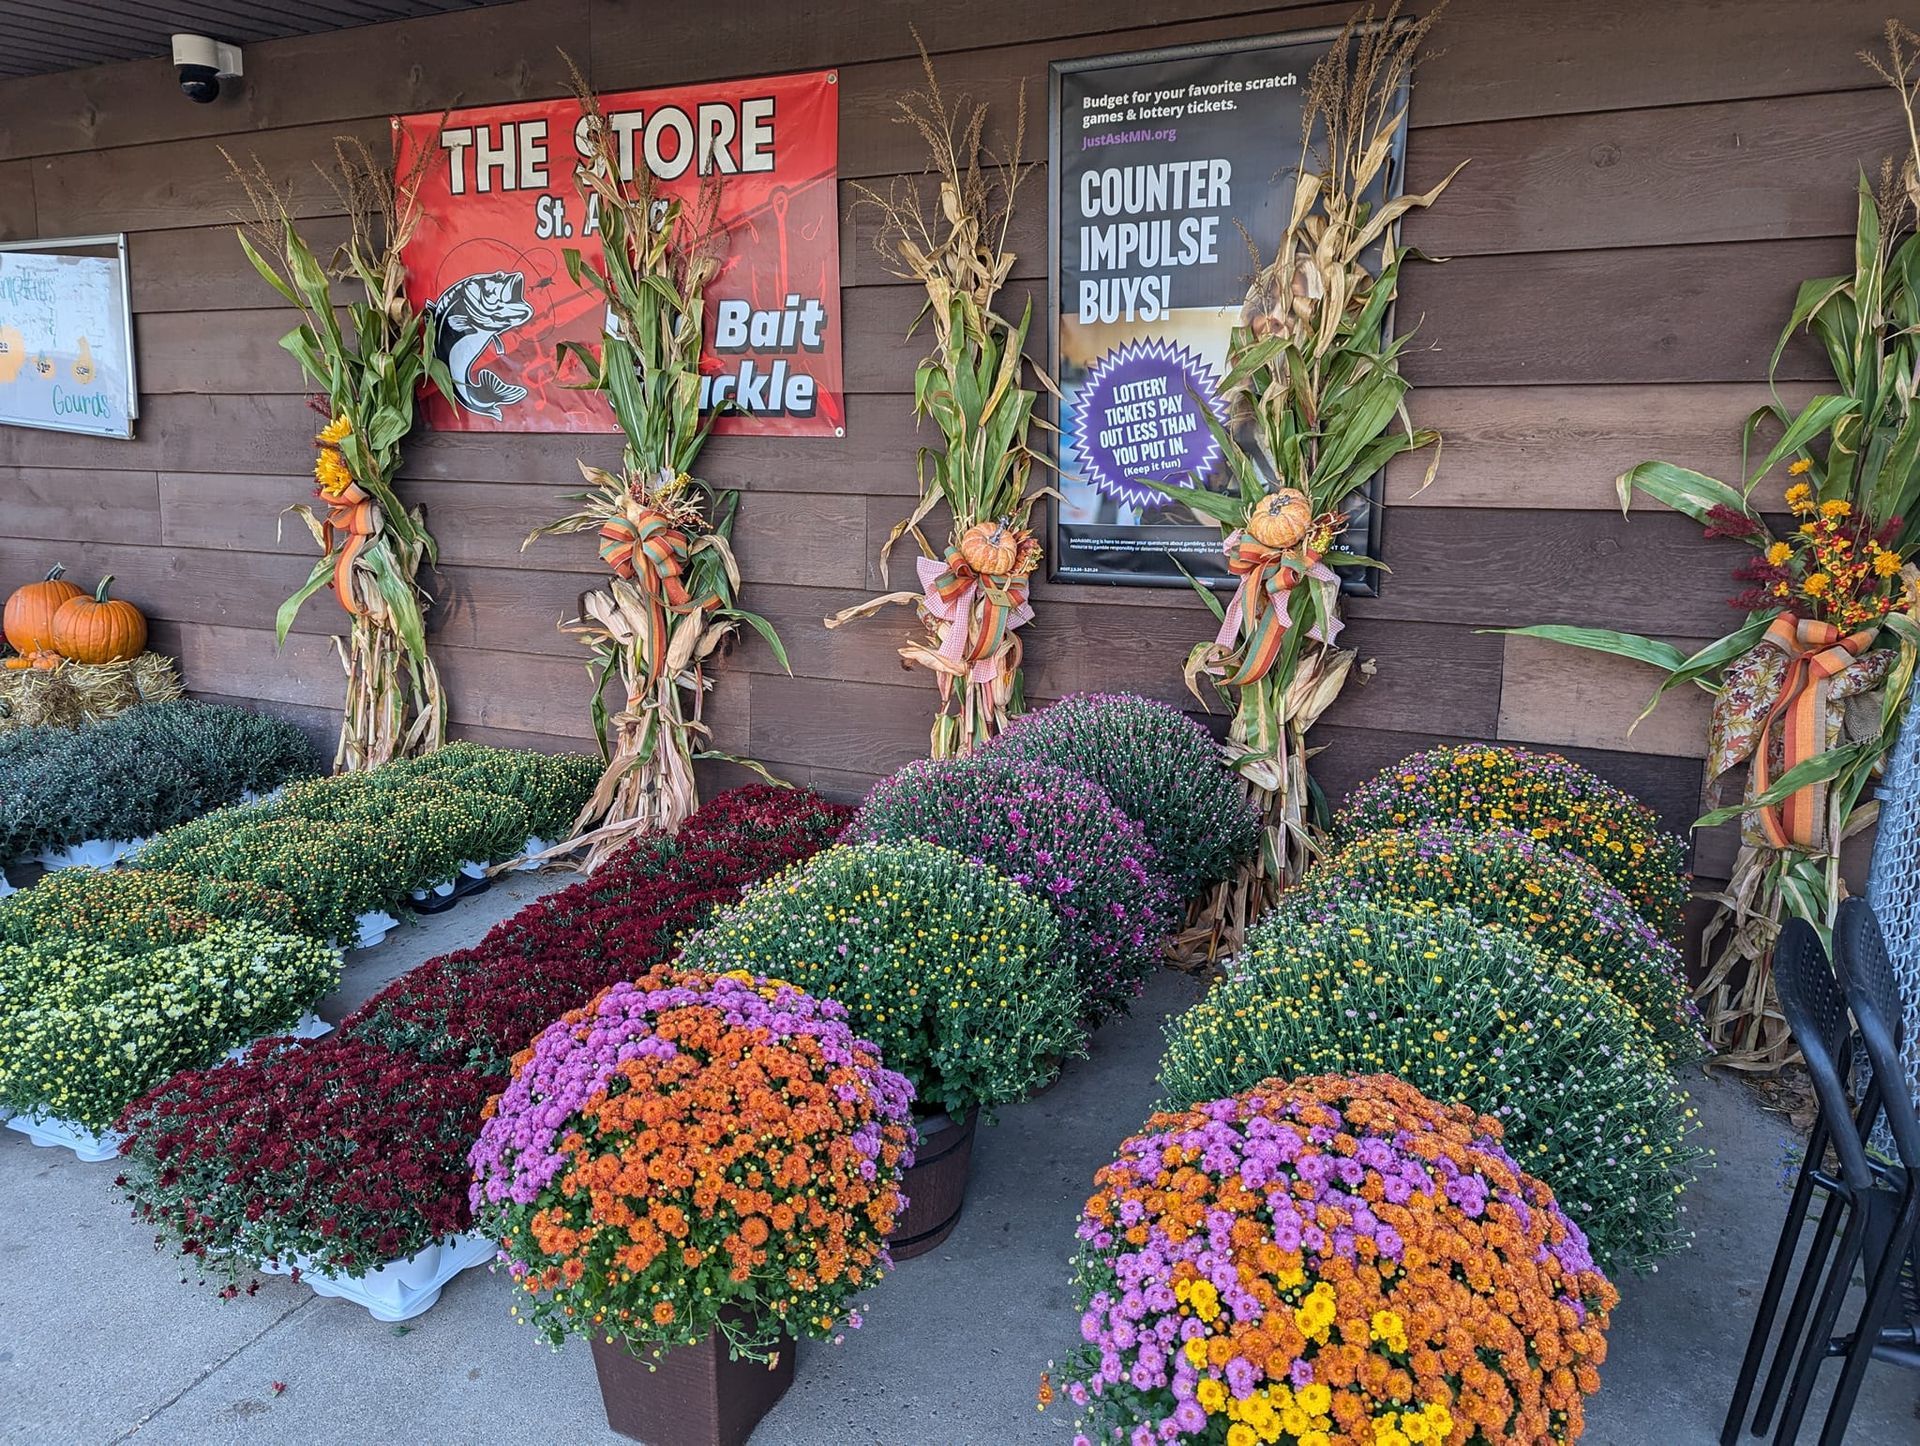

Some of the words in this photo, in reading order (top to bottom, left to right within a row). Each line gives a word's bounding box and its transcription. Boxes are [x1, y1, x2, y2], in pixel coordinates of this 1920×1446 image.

[1082, 94, 1129, 110] Budget
[1131, 91, 1152, 104] for
[1153, 86, 1186, 105] your
[1188, 80, 1243, 97] favorite
[1245, 72, 1298, 91] scratch
[1082, 111, 1124, 129] games
[1126, 109, 1137, 122] &
[1139, 103, 1185, 120] lottery
[1187, 98, 1238, 114] tickets.
[441, 119, 549, 194] THE
[574, 96, 776, 185] STORE
[1081, 128, 1177, 151] JustAskMN.org
[1080, 158, 1232, 218] COUNTER
[535, 194, 572, 240] St.
[1080, 216, 1220, 271] IMPULSE
[1079, 275, 1171, 325] BUYS!
[714, 294, 825, 352] Bait
[52, 384, 111, 419] Gourds
[1113, 376, 1167, 405] LOTTERY
[1104, 400, 1157, 427] TICKETS
[1159, 394, 1183, 416] PAY
[1099, 427, 1123, 449] OUT
[1126, 421, 1158, 443] LESS
[1160, 413, 1197, 436] THAN
[1112, 445, 1139, 466] YOU
[1140, 439, 1166, 461] PUT
[1168, 436, 1189, 456] IN.
[1123, 465, 1150, 478] (Keep
[1151, 462, 1160, 471] it
[1161, 458, 1181, 469] fun)
